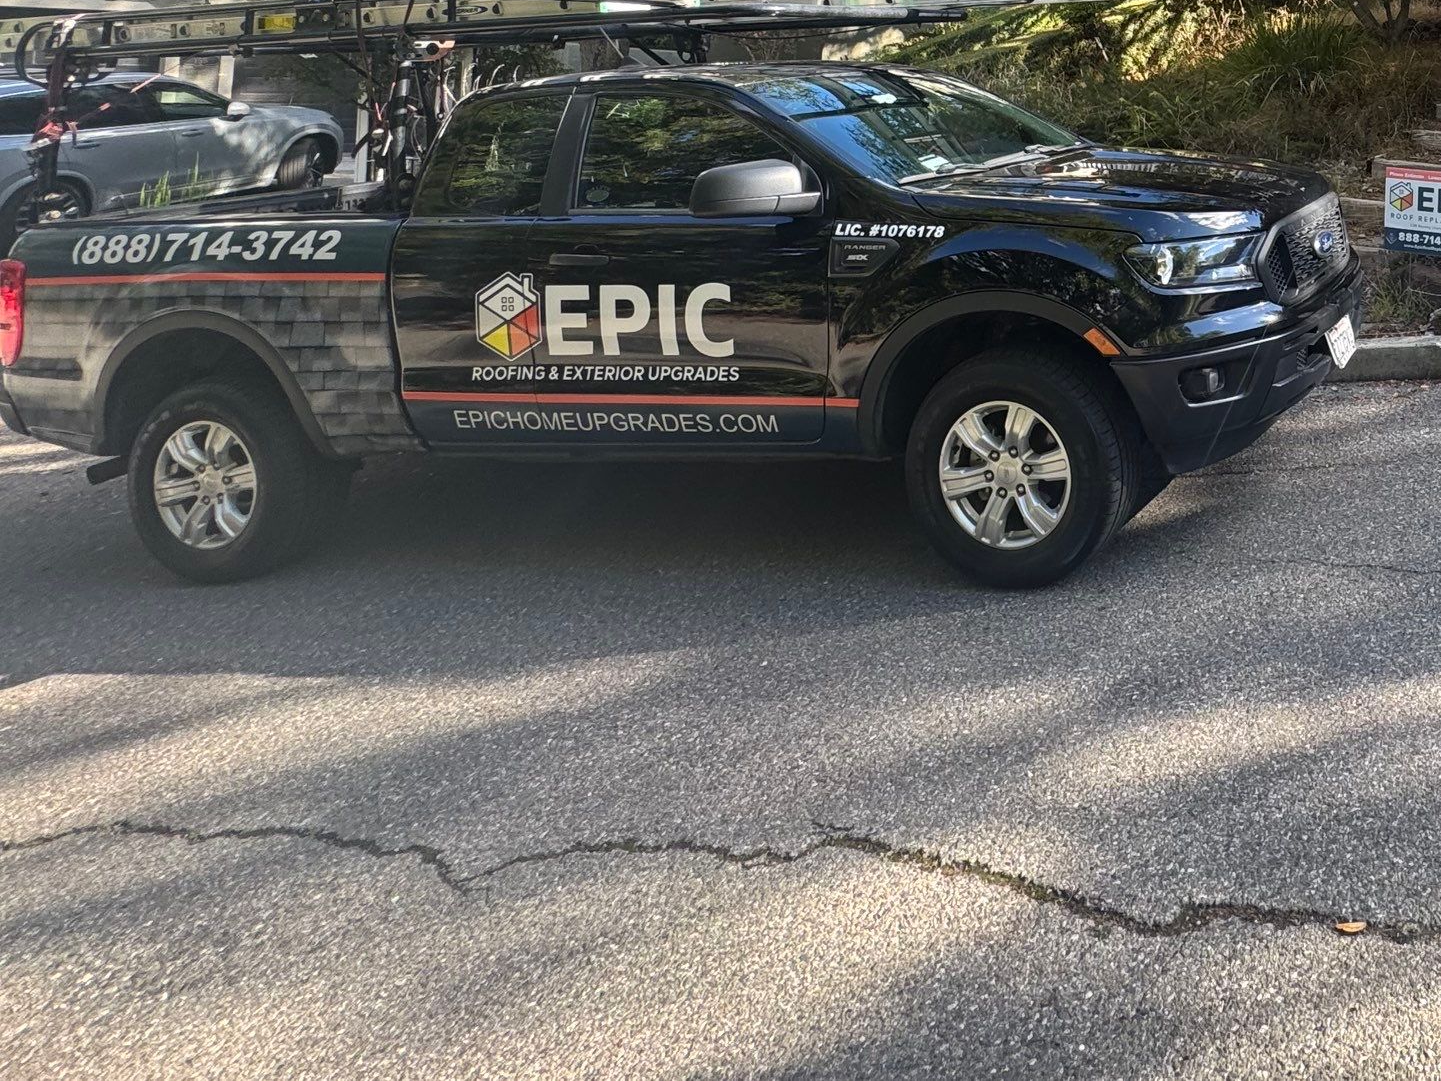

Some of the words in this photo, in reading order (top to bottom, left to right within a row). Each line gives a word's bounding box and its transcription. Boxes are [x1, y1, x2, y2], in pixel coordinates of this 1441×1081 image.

[1390, 212, 1414, 221] ROOF
[835, 223, 865, 237] LIC.
[869, 224, 945, 238] #1076178
[72, 230, 342, 265] (888)714-3742
[544, 282, 735, 358] EPIC
[471, 366, 546, 381] ROOFING
[548, 366, 560, 380] &
[563, 366, 646, 381] EXTERIOR
[648, 366, 740, 382] UPGRADES
[453, 410, 779, 433] EPICHOMEUPGRADES.COM
